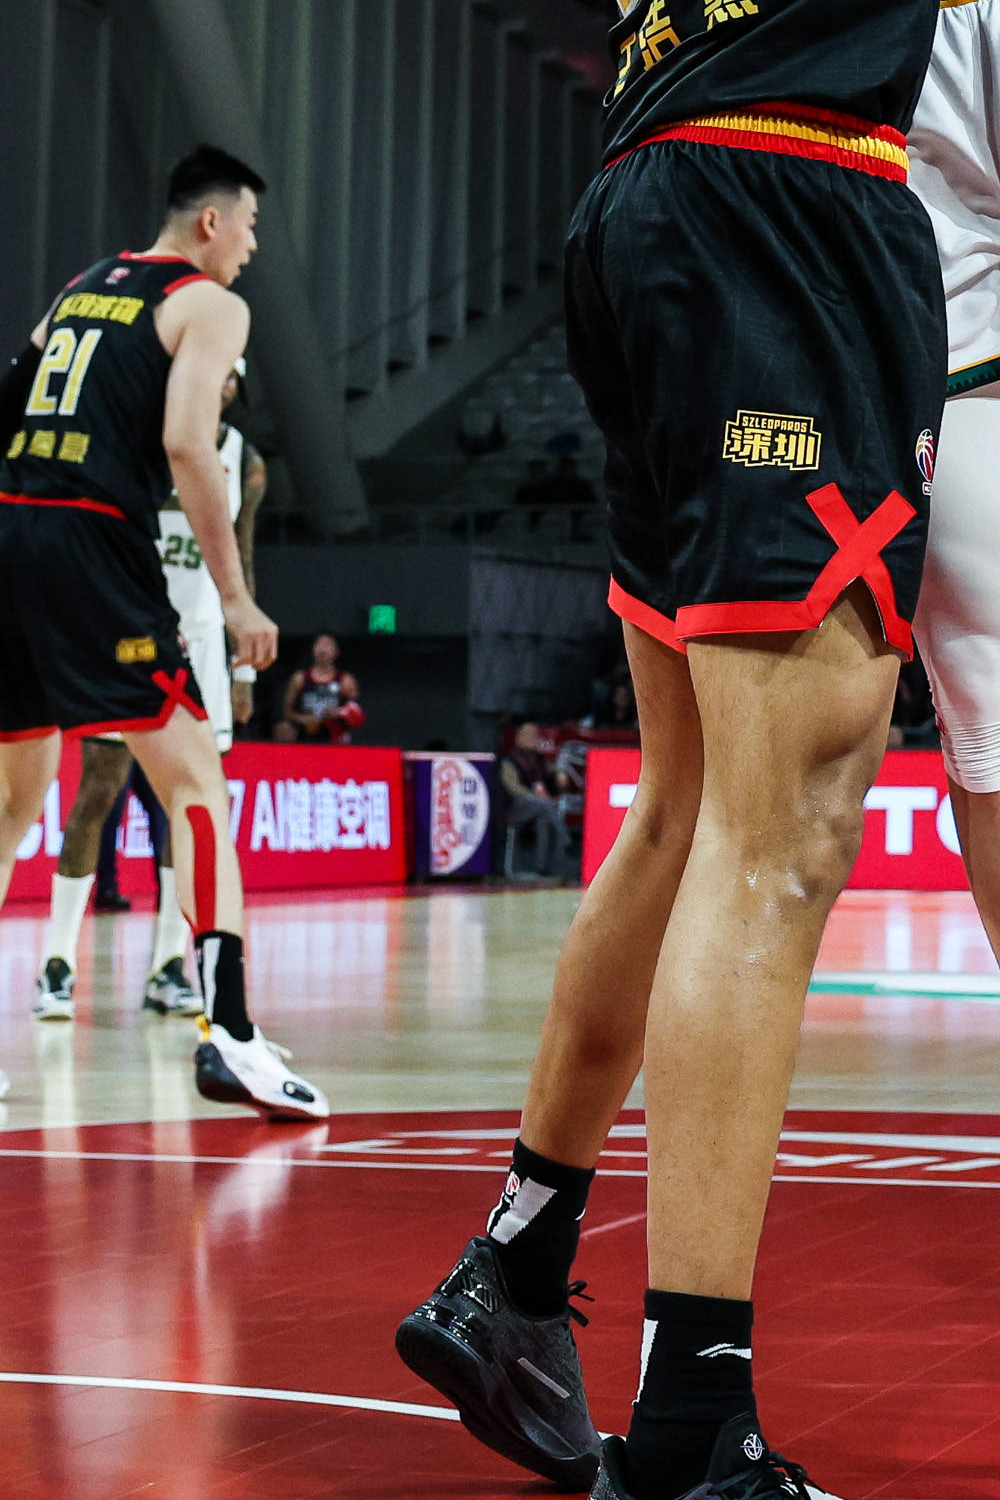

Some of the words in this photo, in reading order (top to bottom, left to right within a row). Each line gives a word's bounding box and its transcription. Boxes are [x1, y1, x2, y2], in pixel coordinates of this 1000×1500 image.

[25, 327, 103, 416] 21
[742, 416, 808, 433] SZLEOPARDS
[729, 427, 816, 466] 深圳
[162, 534, 202, 570] 25
